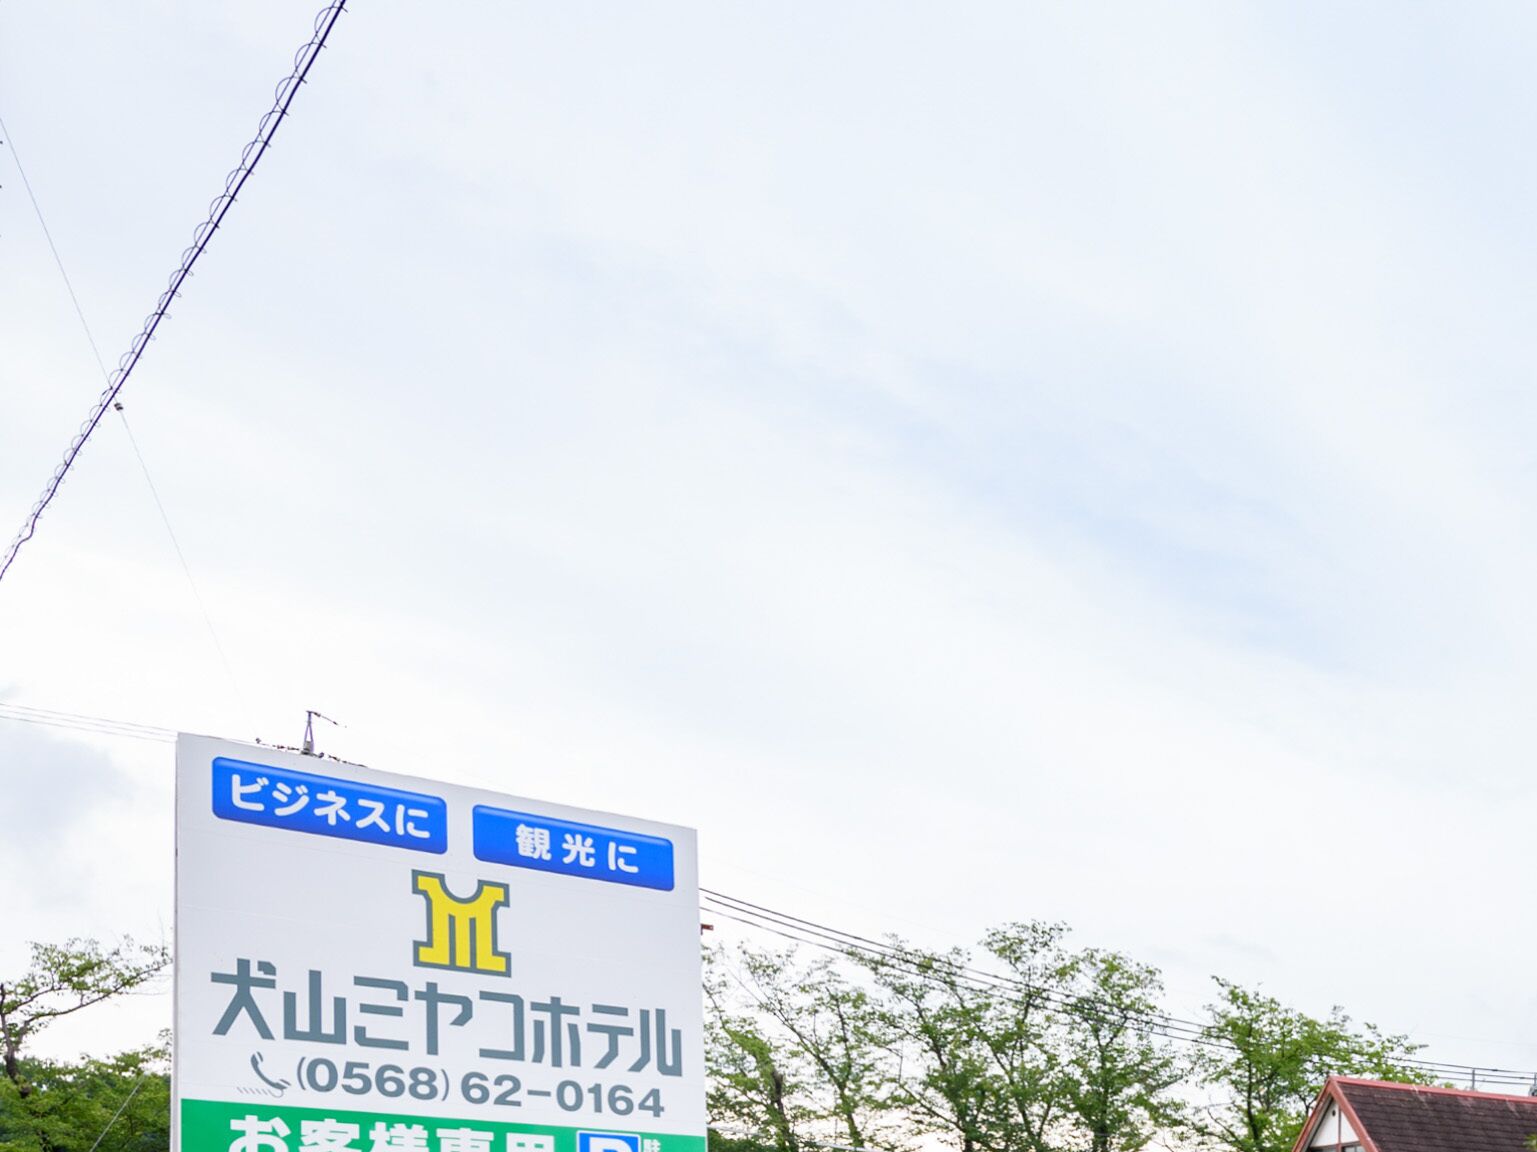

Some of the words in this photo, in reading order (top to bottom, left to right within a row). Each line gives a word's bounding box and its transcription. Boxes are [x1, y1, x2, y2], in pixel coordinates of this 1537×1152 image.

[230, 775, 430, 841] ビジネスに
[514, 823, 640, 874] 観光に
[210, 957, 682, 1077] 犬山ミヤコホテル
